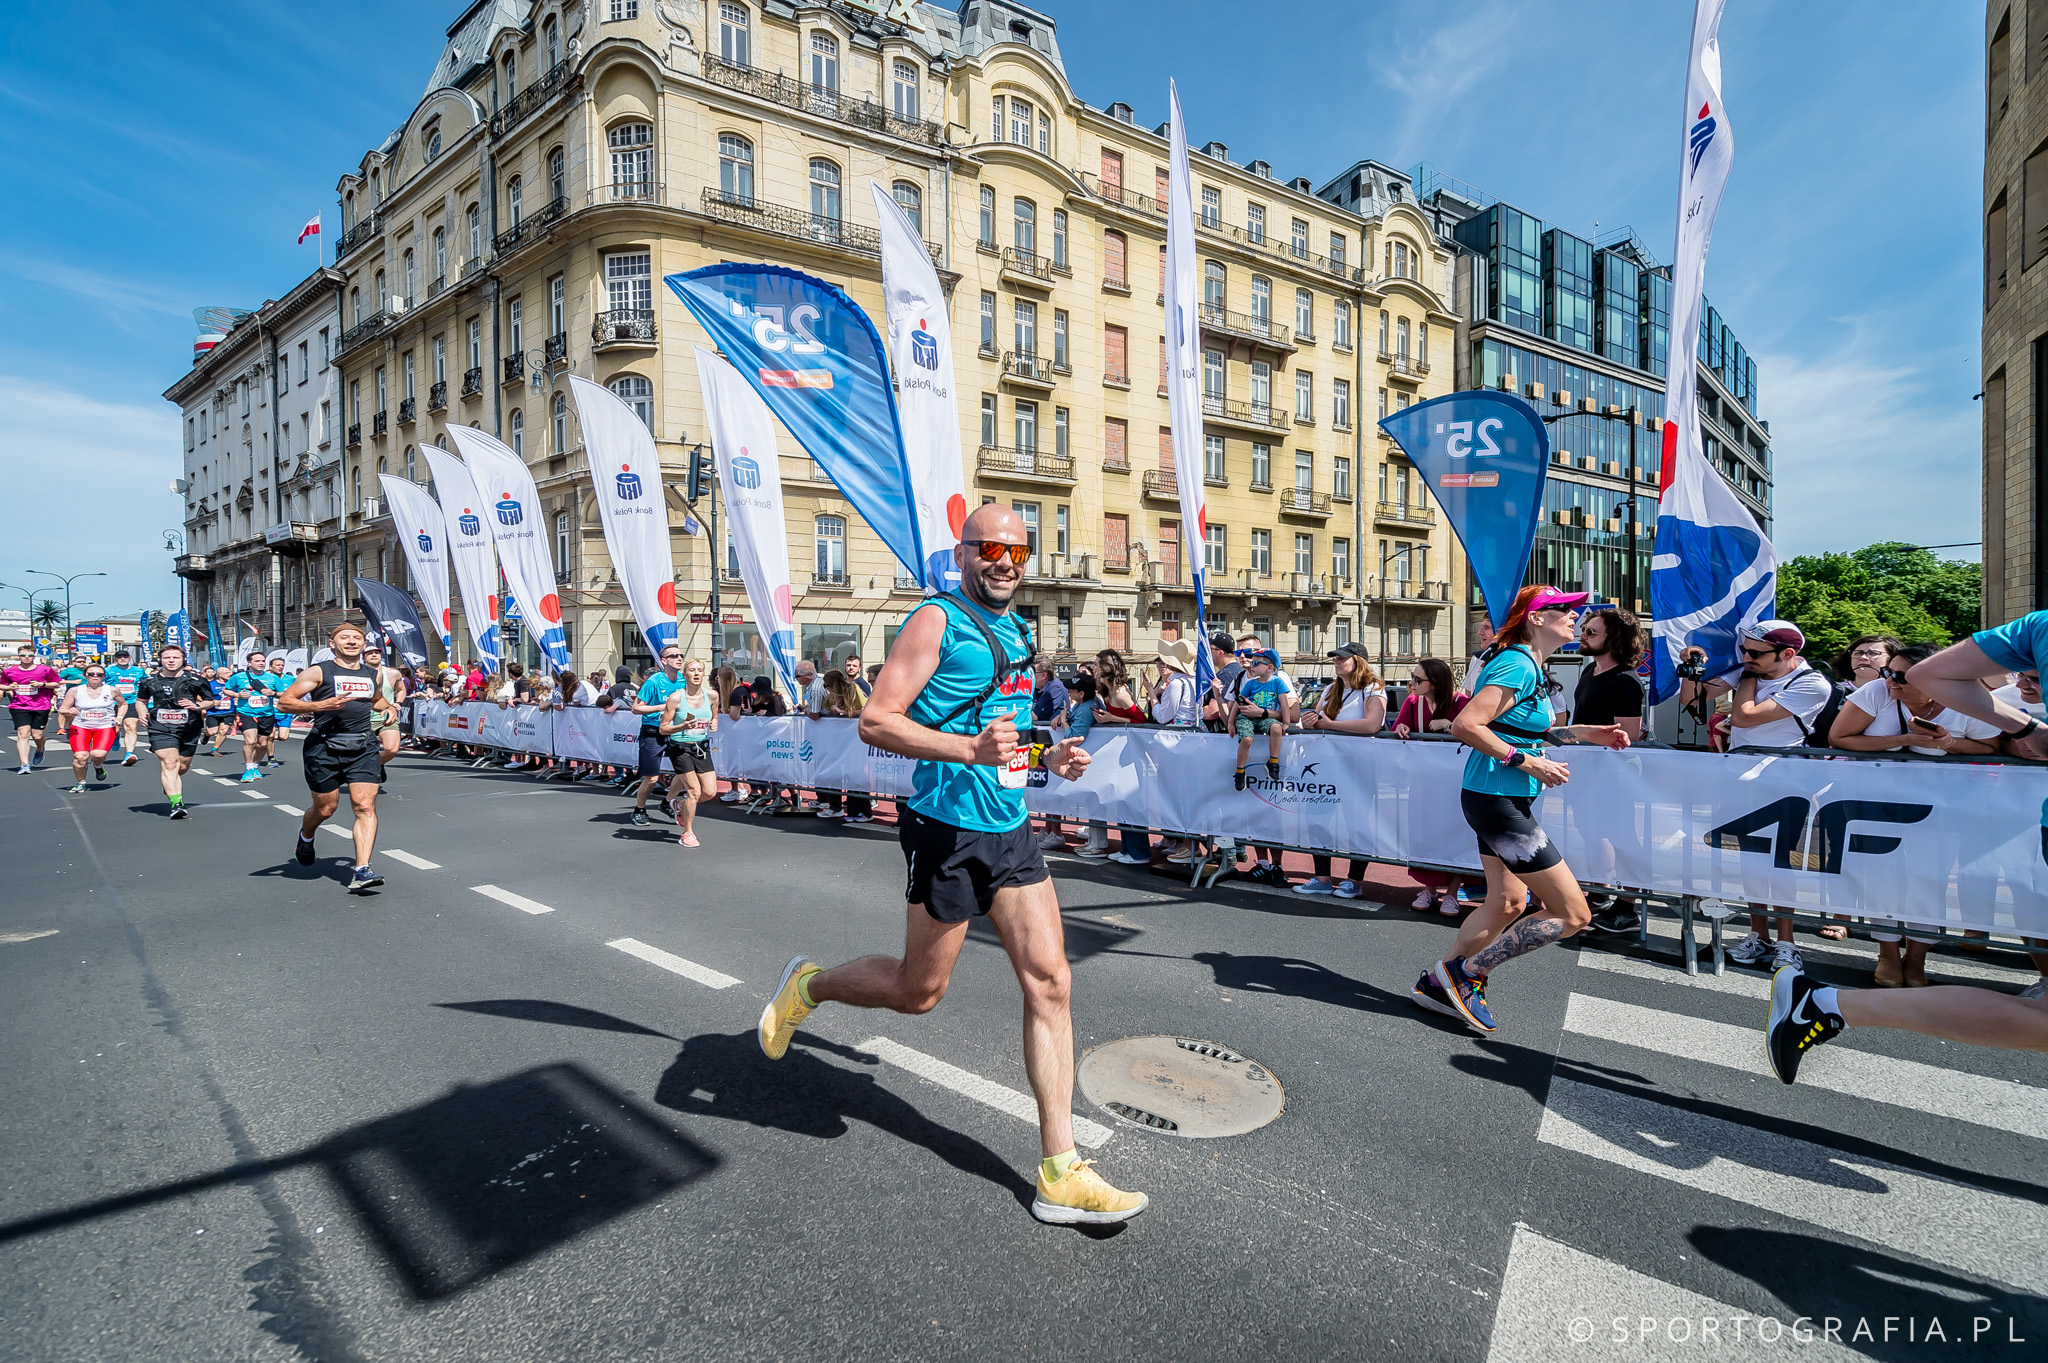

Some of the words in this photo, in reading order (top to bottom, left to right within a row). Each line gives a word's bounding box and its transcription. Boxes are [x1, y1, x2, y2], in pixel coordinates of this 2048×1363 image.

[180, 613, 189, 640] SPORT
[344, 683, 368, 691] 7388
[771, 751, 794, 760] news
[874, 762, 907, 775] SPORT
[1246, 775, 1336, 796] Primavera
[1268, 791, 1300, 805] Woda
[1703, 795, 1934, 875] 4F
